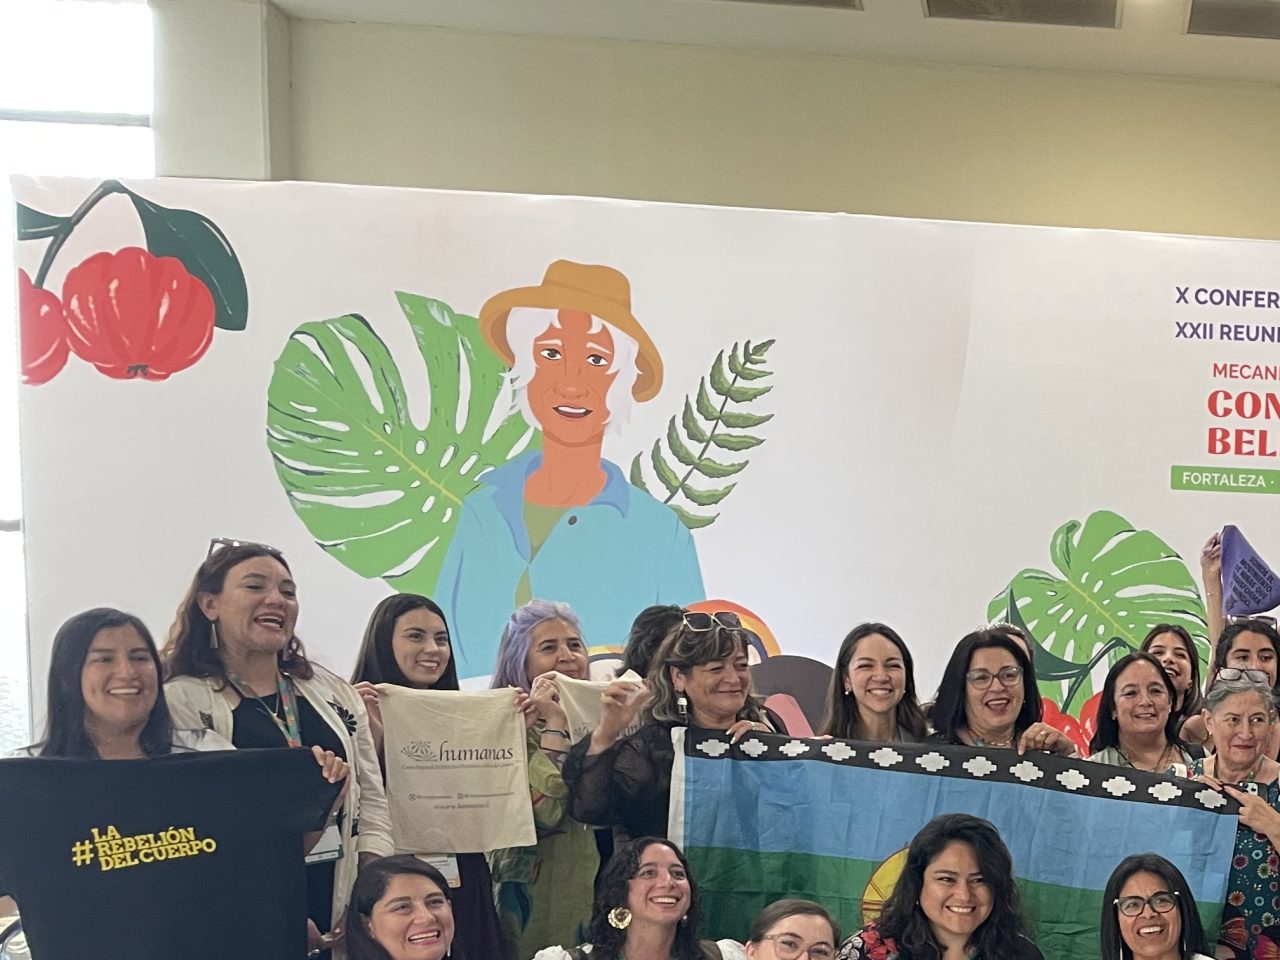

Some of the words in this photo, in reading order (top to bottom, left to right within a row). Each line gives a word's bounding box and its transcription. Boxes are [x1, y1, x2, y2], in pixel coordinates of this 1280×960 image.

[1175, 286, 1190, 305] X
[1175, 321, 1214, 340] XXII
[1182, 471, 1267, 488] FORTALEZA
[440, 740, 514, 761] humanas
[91, 825, 122, 843] LA
[95, 826, 196, 857] REBELIÓN
[99, 853, 140, 872] DEL
[138, 838, 217, 863] CUERPO
